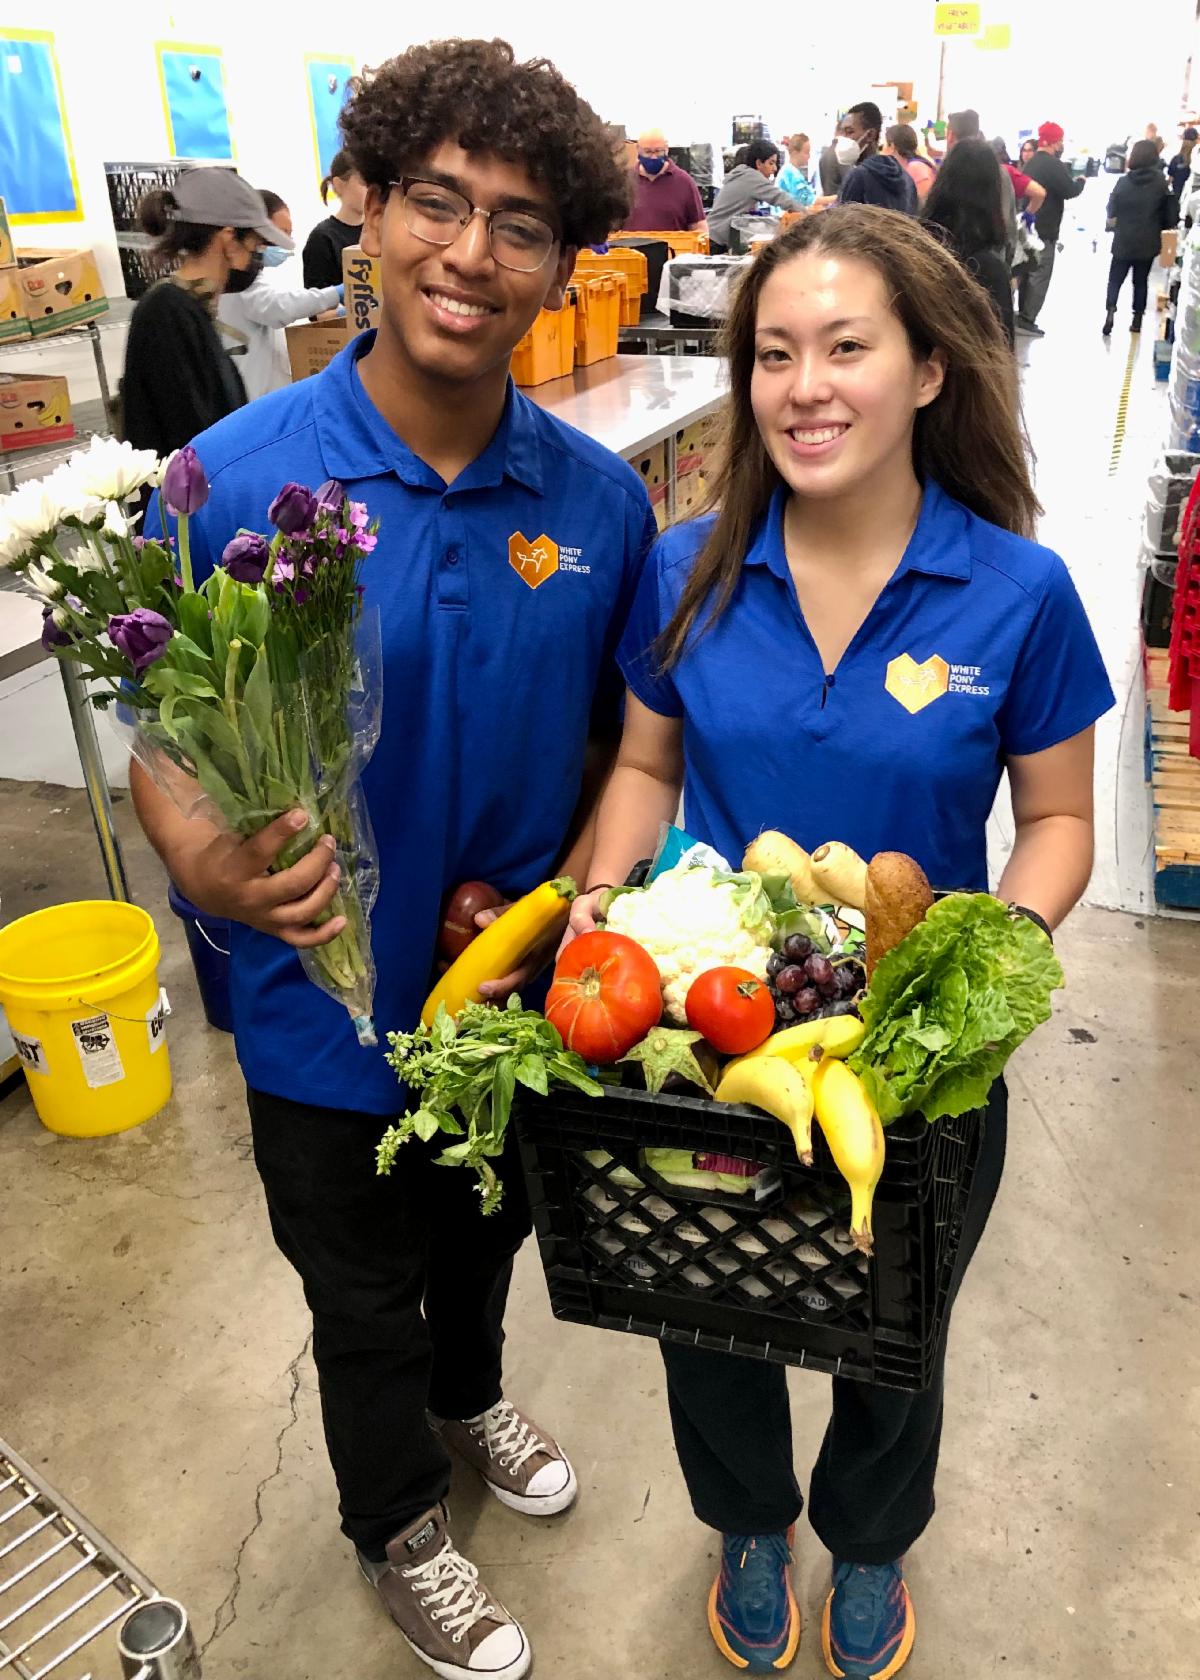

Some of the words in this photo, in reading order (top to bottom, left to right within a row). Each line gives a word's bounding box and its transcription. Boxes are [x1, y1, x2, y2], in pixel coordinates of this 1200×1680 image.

[347, 259, 379, 329] Fyffes
[559, 545, 583, 557] WHITE
[559, 555, 578, 564] PONY
[560, 563, 591, 574] EXPRESS
[949, 664, 982, 676] WHITE
[949, 674, 975, 685] PONY
[948, 683, 990, 696] EXPRESS
